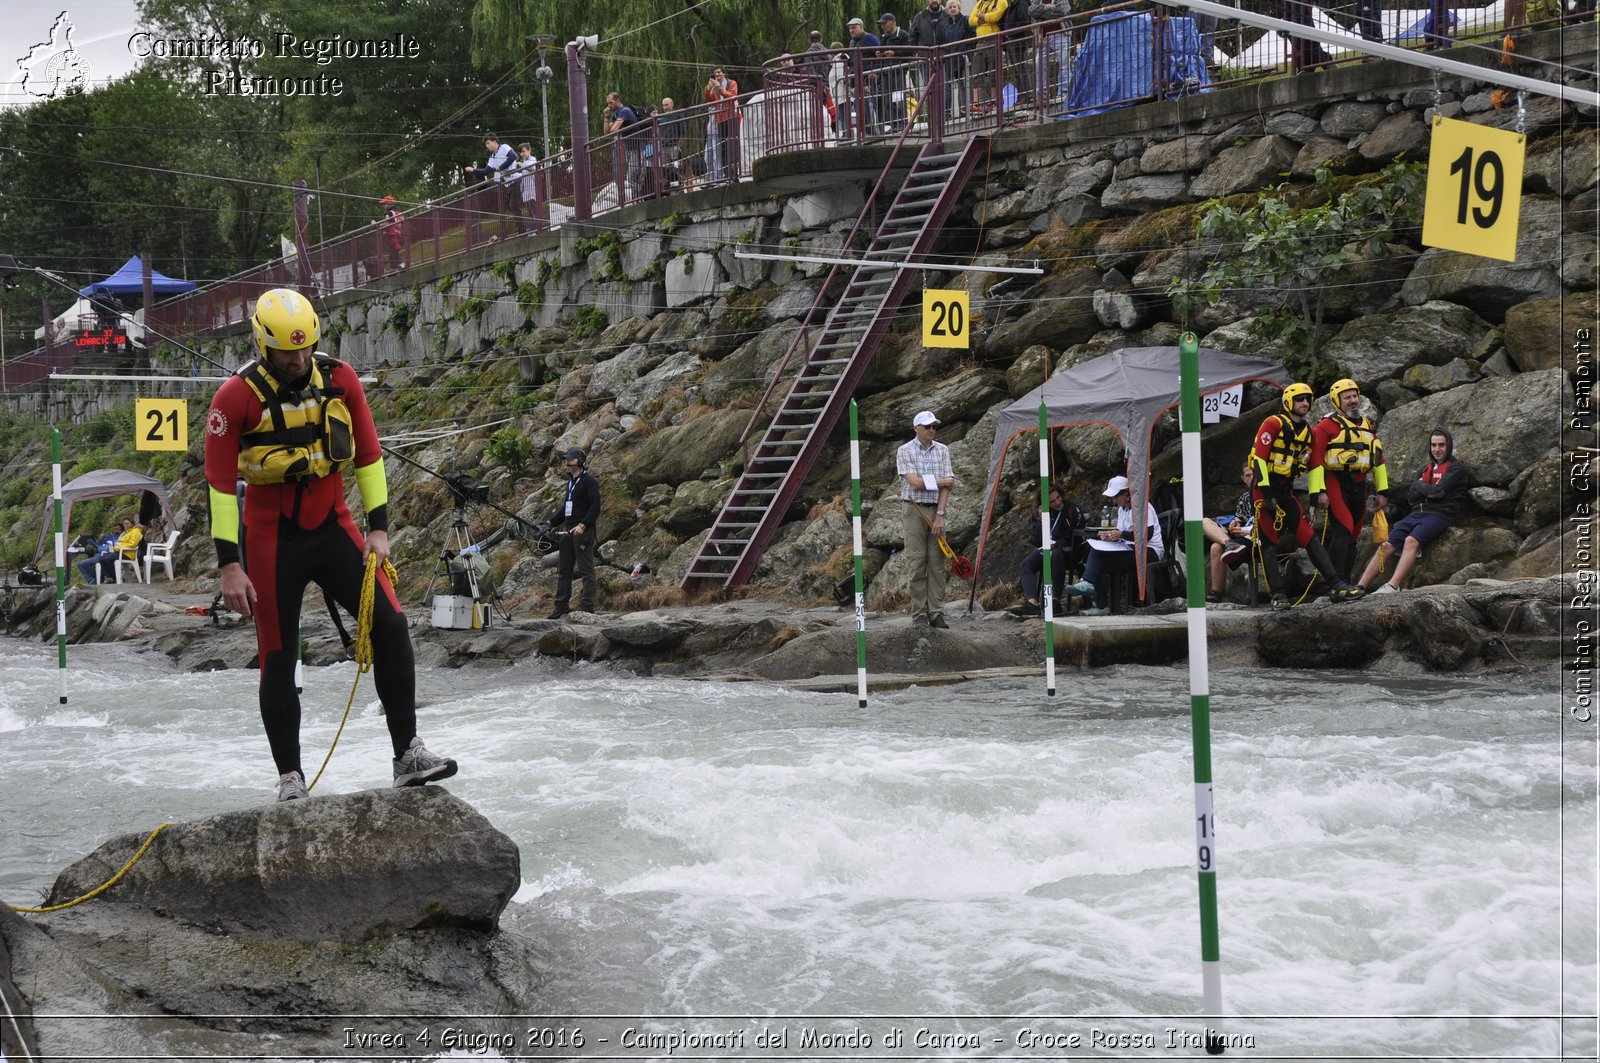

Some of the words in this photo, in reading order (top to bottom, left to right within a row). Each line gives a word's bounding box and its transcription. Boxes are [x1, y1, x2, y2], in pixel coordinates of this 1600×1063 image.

[1450, 146, 1504, 229] 19
[930, 300, 964, 337] 20
[1204, 398, 1219, 412] 23
[1222, 392, 1239, 407] 24
[146, 409, 179, 441] 21
